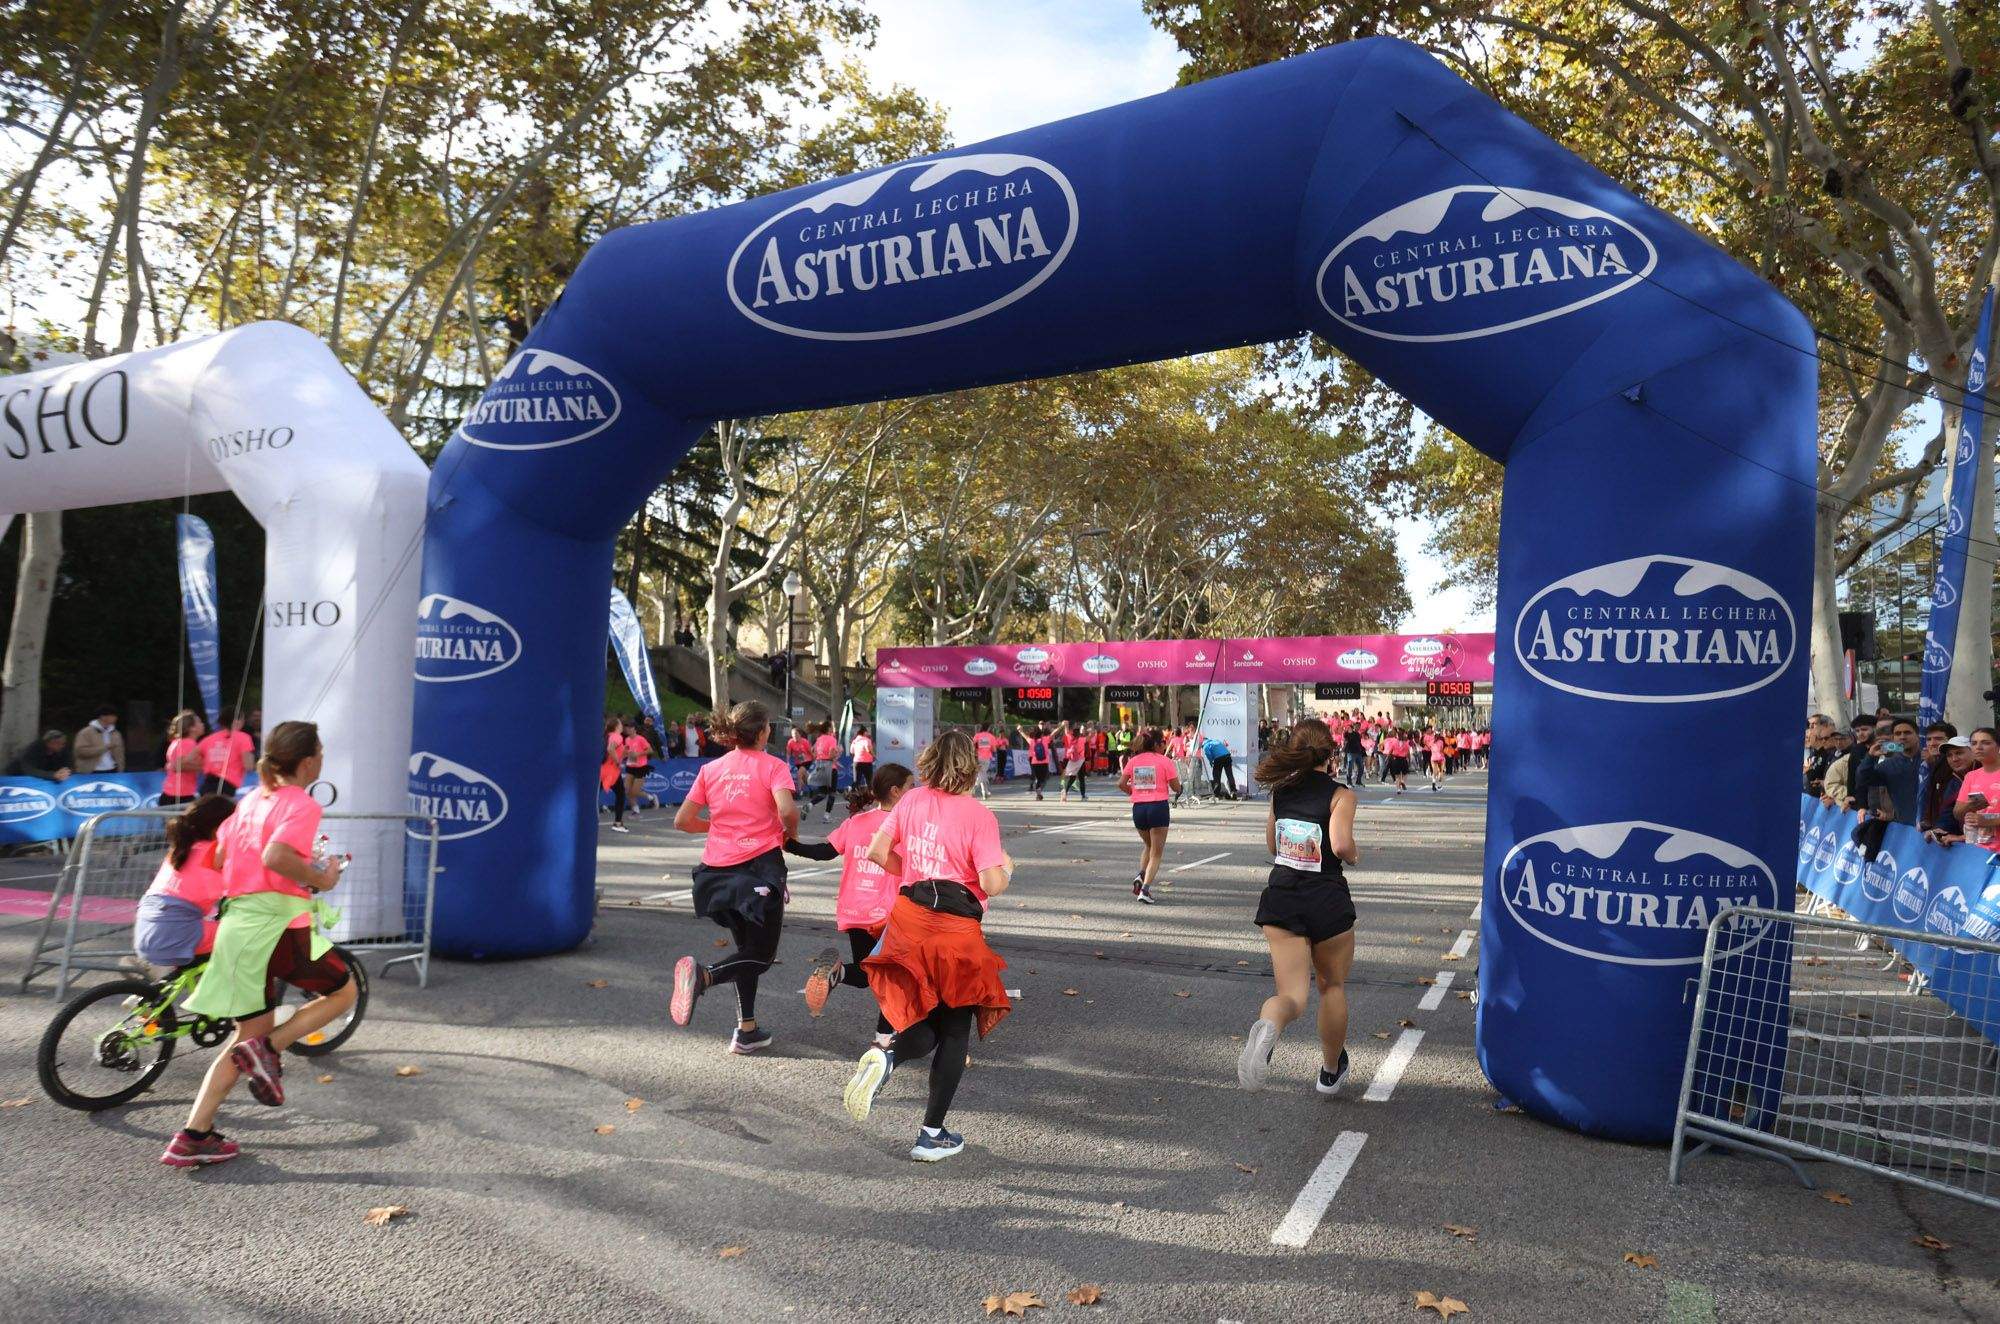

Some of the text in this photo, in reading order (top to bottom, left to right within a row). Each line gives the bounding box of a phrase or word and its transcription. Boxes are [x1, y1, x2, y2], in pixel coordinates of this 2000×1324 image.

[800, 177, 1033, 243] CENTRAL LECHERA
[1373, 223, 1613, 268] CENTRAL LECHERA
[752, 206, 1051, 309] ASTURIANA
[1344, 242, 1632, 317] ASTURIANA
[531, 380, 593, 392] LECHERA
[0, 370, 128, 459] SHO
[208, 427, 294, 463] OYSHO
[1568, 606, 1777, 621] CENTRAL LECHERA
[1527, 609, 1782, 665] ASTURIANA
[1086, 660, 1117, 670] ASTURIANA
[1137, 660, 1167, 669] OYSHO
[1185, 660, 1216, 669] Santander
[1233, 660, 1264, 668] Santander
[1283, 657, 1316, 666] OYSHO
[1341, 656, 1376, 665] ASTURIANA
[921, 664, 948, 673] OYSHO
[956, 689, 982, 697] OYSHO
[1111, 689, 1140, 698] OYSHO
[1322, 687, 1355, 695] OYSHO
[1019, 701, 1053, 709] OYSHO
[1429, 696, 1471, 705] OYSHO
[1207, 718, 1240, 726] OYSHO
[1551, 861, 1758, 888] CENTRAL LECHERA
